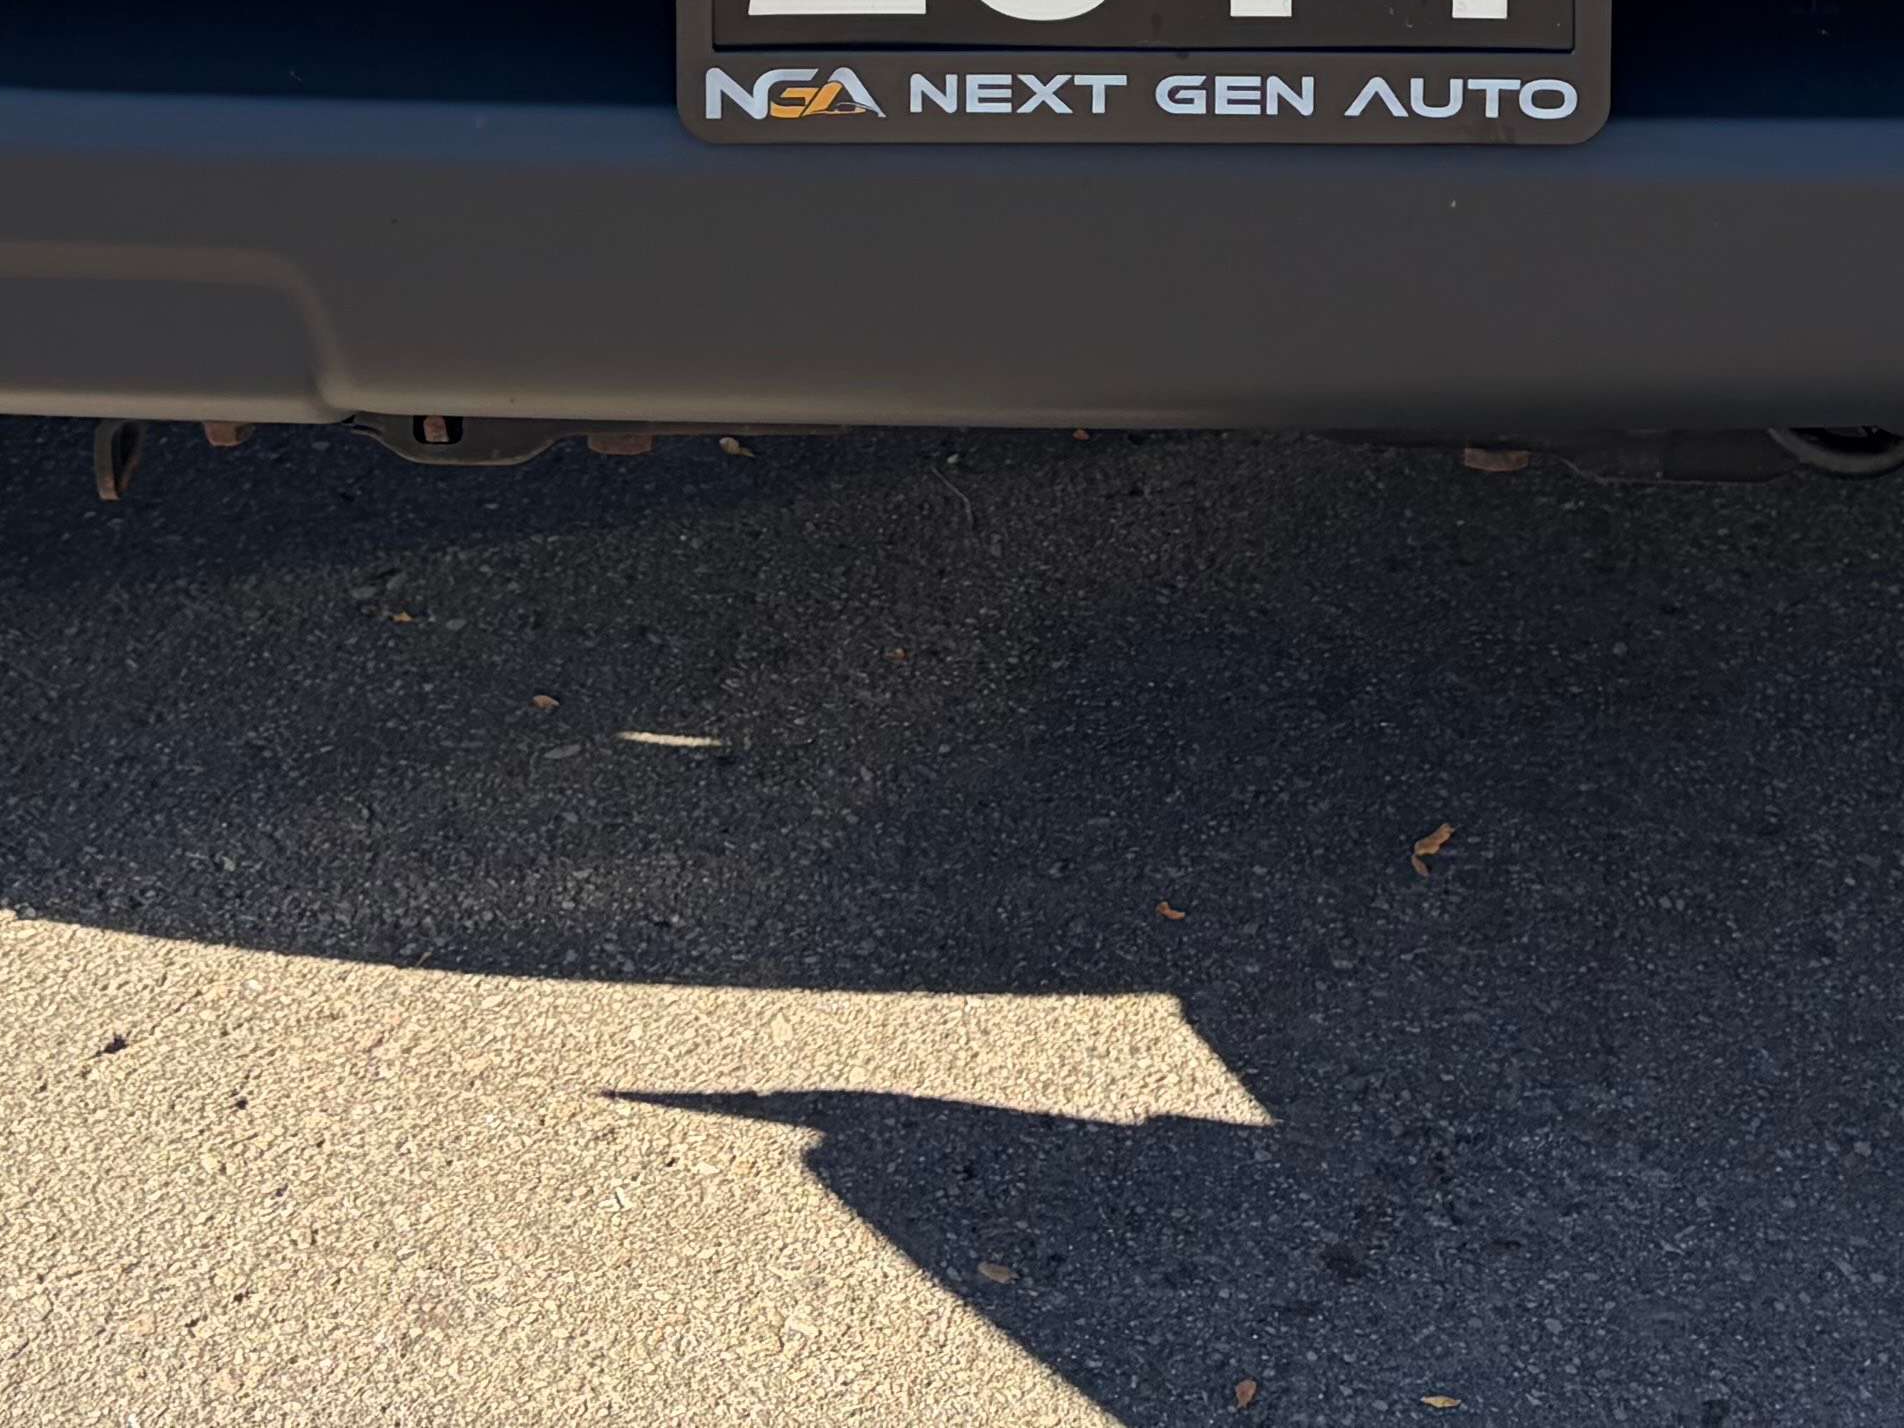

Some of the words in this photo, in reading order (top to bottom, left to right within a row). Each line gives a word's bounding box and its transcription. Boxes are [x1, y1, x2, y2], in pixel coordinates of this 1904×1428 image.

[704, 66, 887, 122] NGA
[909, 72, 1128, 117] NEXT
[1154, 74, 1316, 118] GEN
[1343, 75, 1579, 121] AUTO
